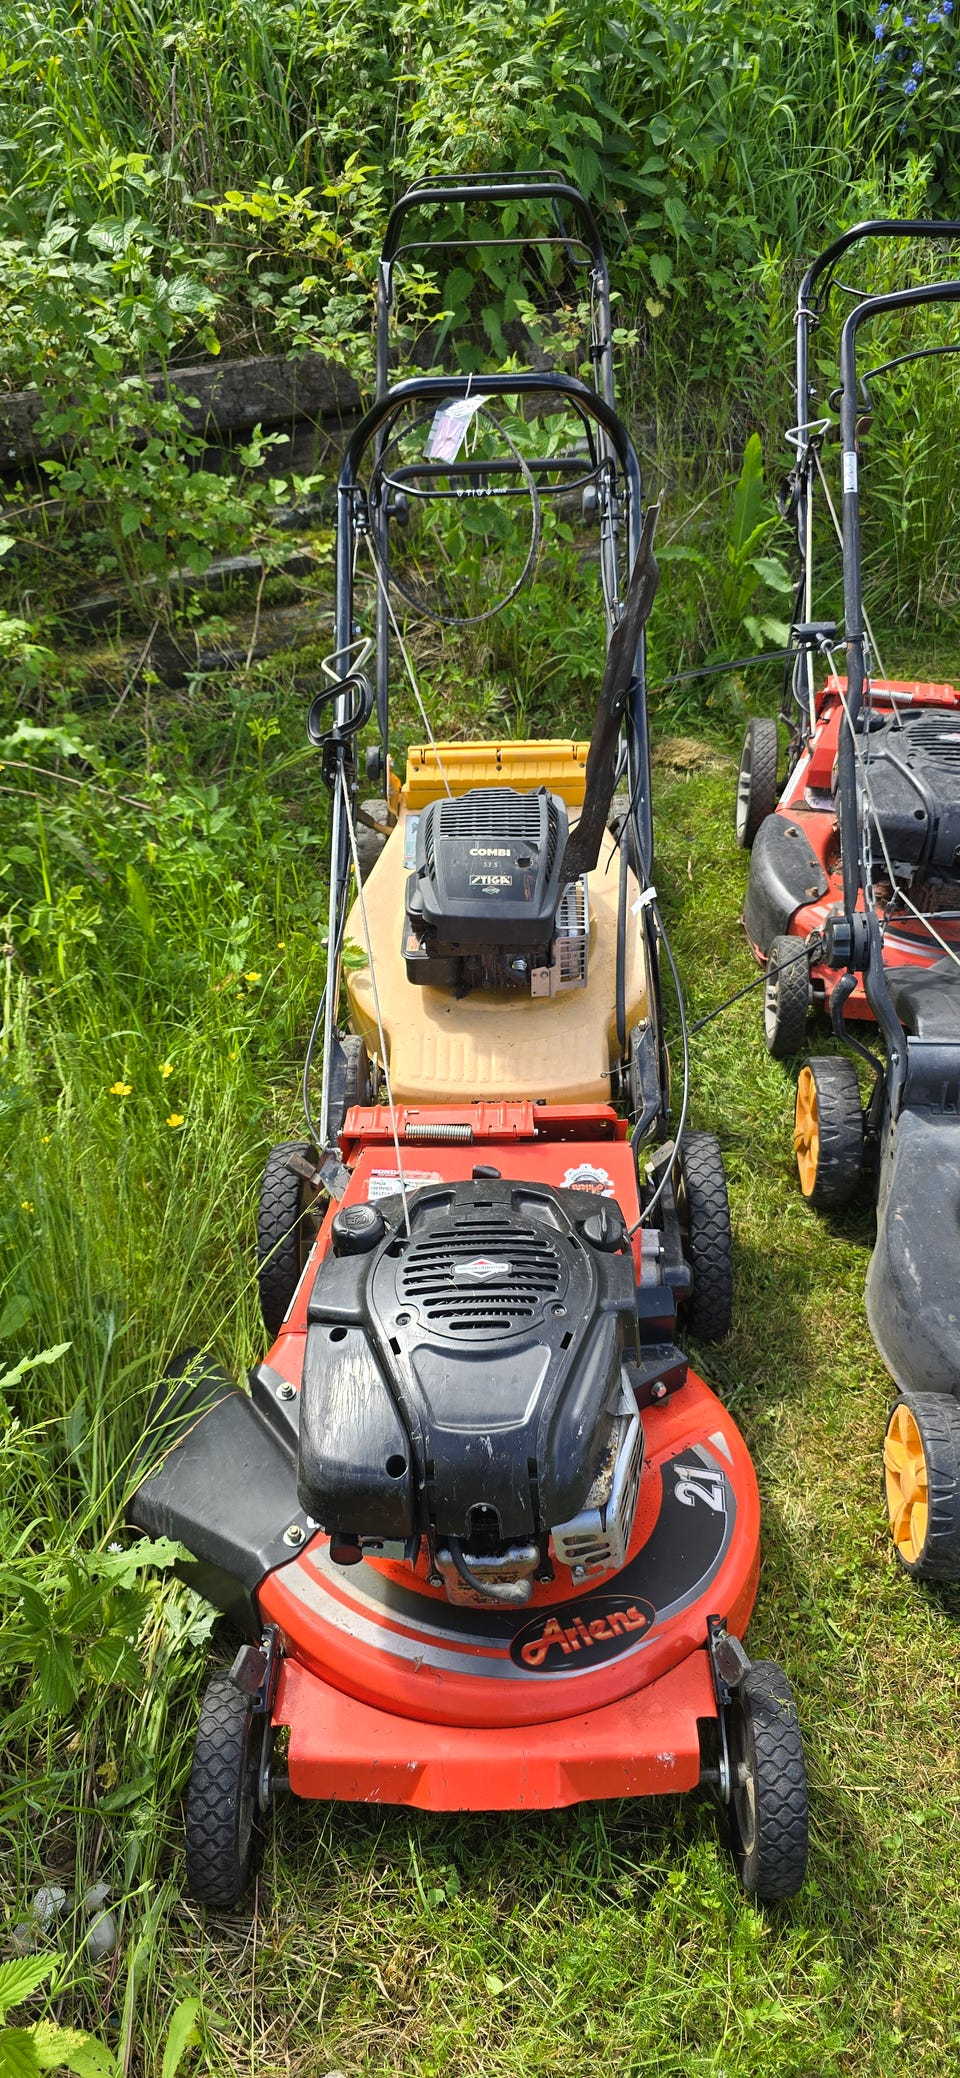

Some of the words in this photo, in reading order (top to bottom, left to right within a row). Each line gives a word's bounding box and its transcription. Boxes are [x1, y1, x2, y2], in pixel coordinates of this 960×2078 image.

[469, 848, 511, 857] COMBI
[471, 875, 510, 884] STIGA
[673, 1463, 727, 1513] 21
[520, 1605, 647, 1666] Ariens
